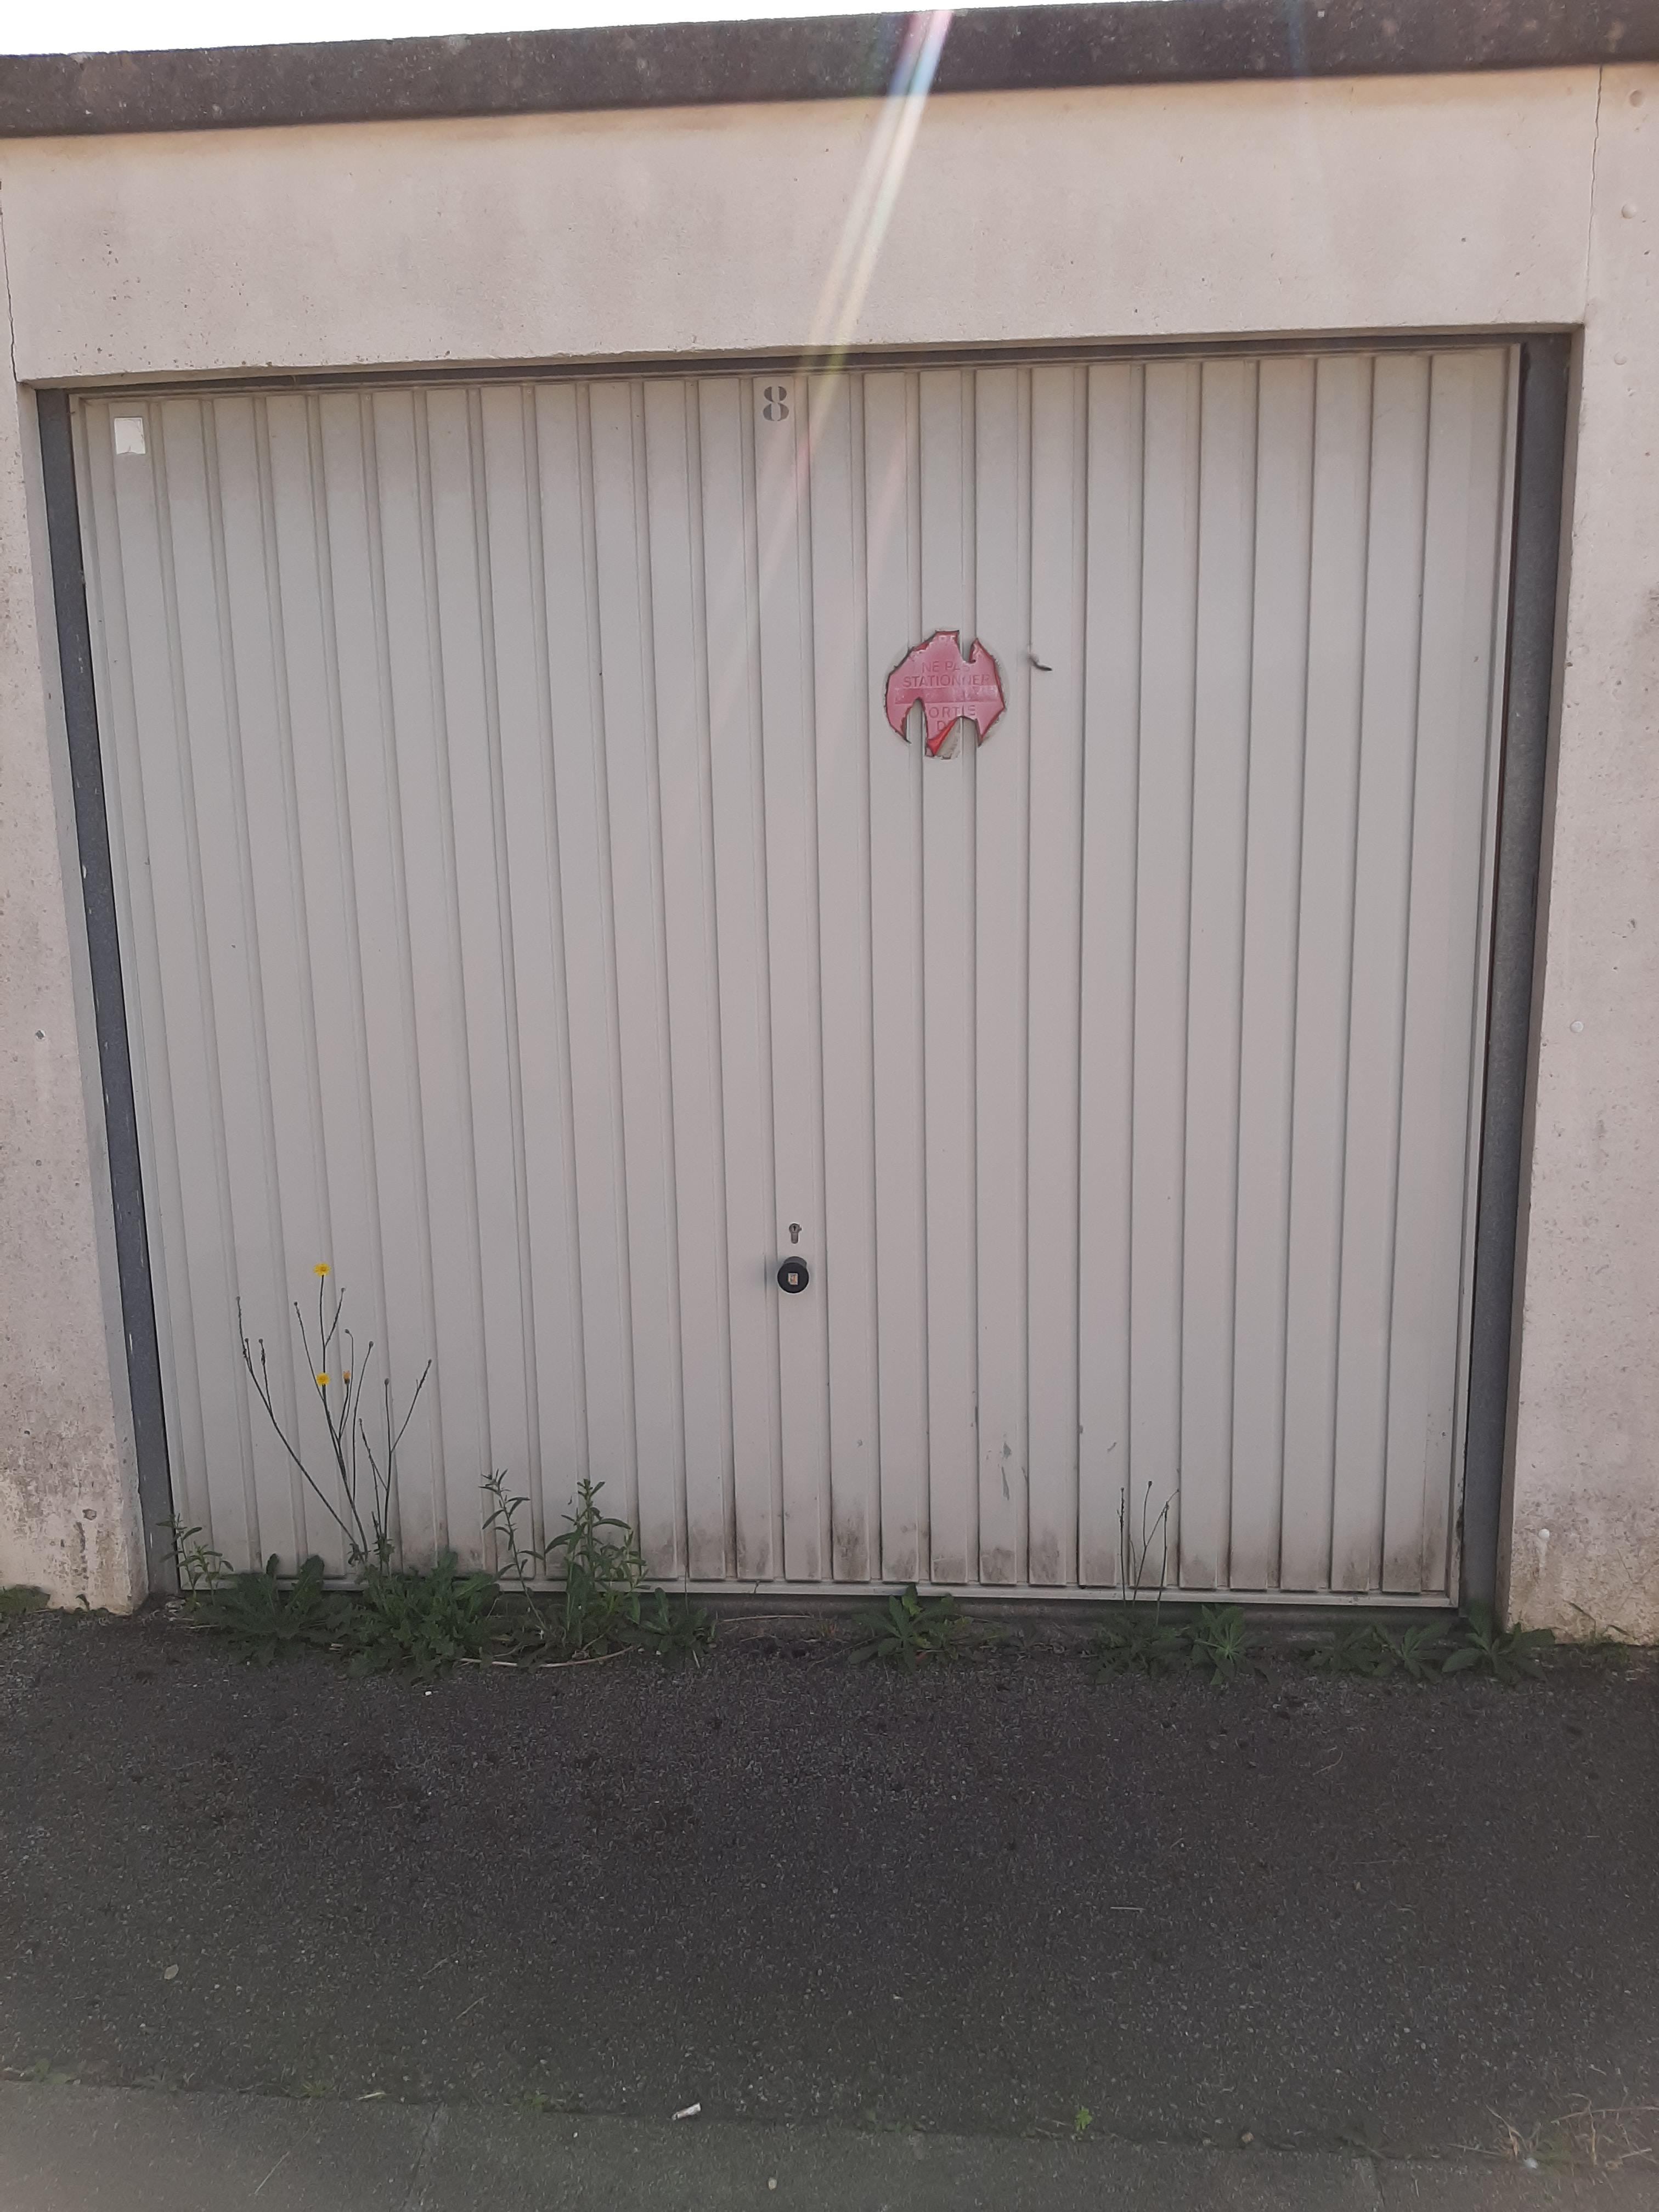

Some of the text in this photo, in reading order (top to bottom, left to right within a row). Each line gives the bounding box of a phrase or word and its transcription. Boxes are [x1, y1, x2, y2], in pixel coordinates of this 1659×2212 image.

[763, 386, 789, 421] 8
[922, 660, 940, 673] NE
[902, 673, 990, 687] STATIONNER
[928, 704, 975, 718] ORTIE
